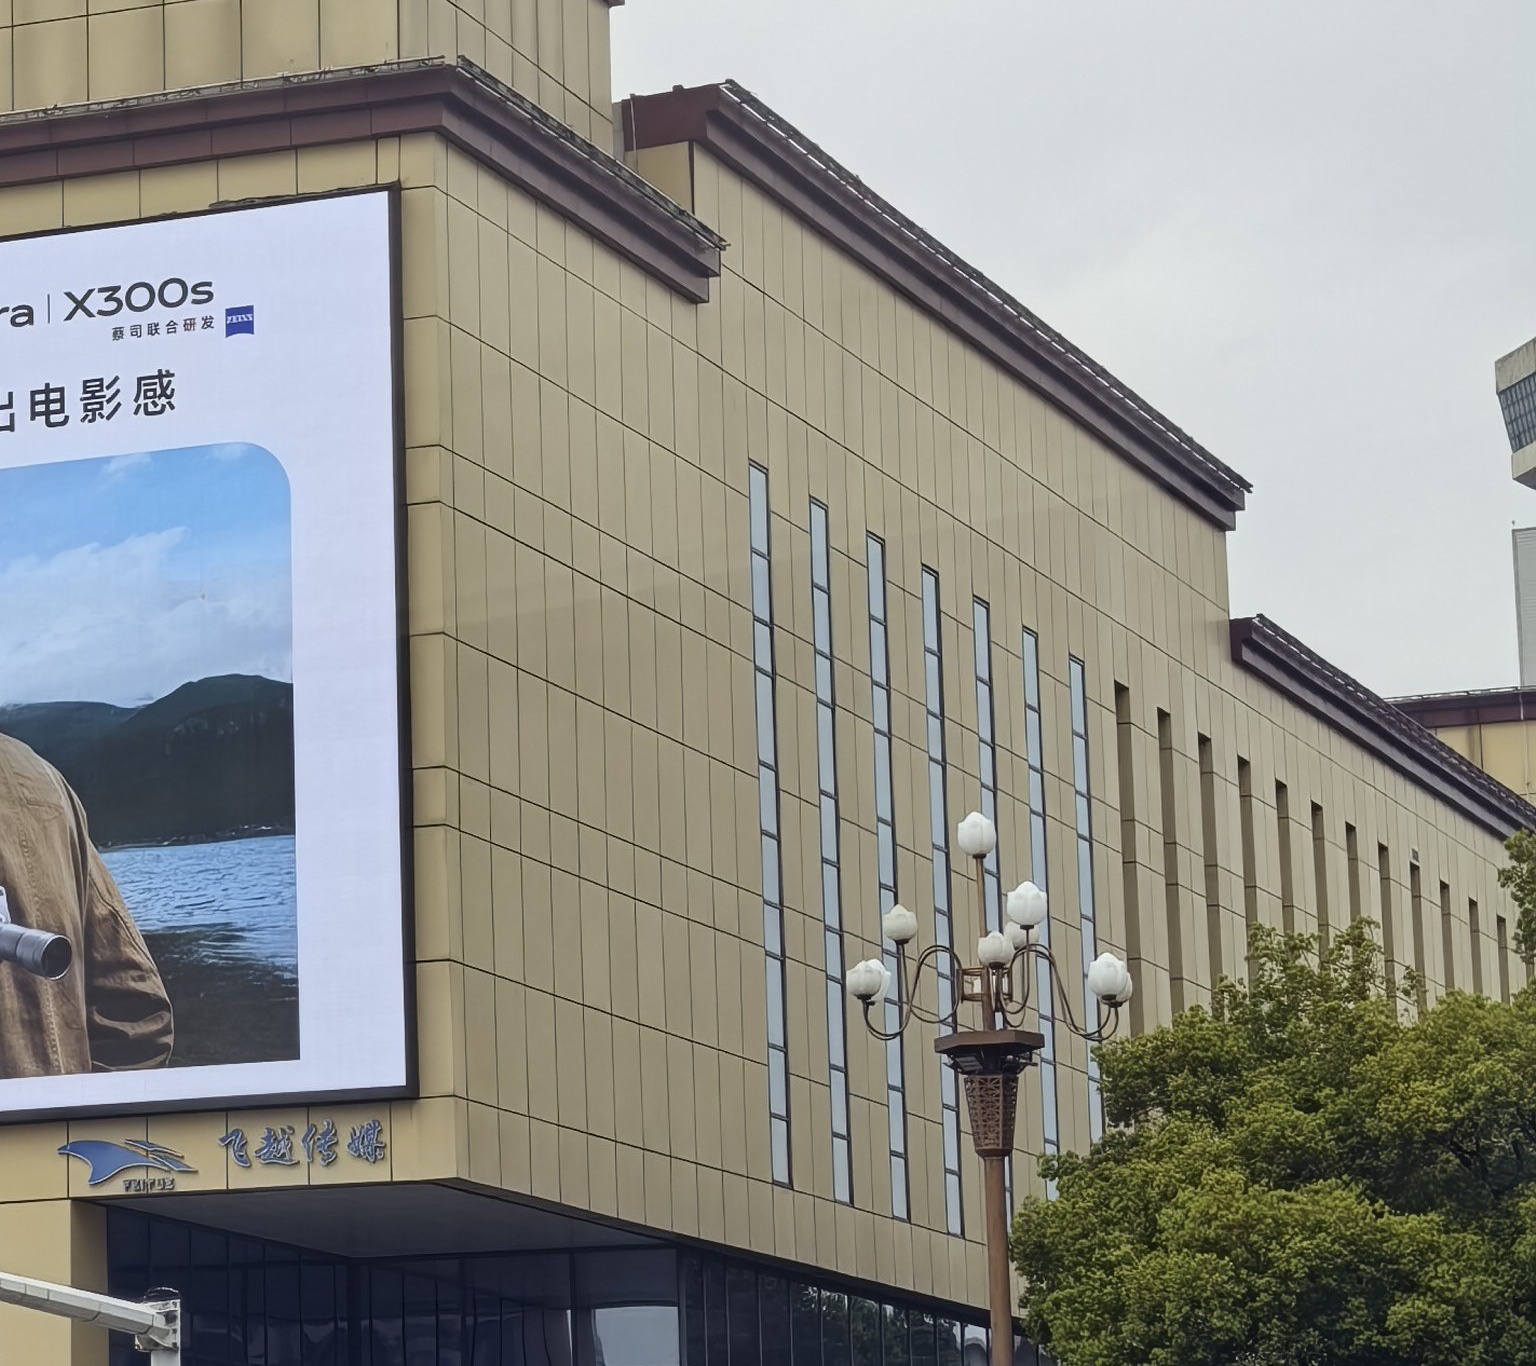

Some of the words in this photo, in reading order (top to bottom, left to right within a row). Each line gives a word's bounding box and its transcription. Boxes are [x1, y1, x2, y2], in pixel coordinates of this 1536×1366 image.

[63, 277, 214, 322] X300s
[112, 315, 215, 341] 蔡司联合研发
[226, 313, 254, 324] ZEISS
[218, 1119, 387, 1168] 飞越传媒
